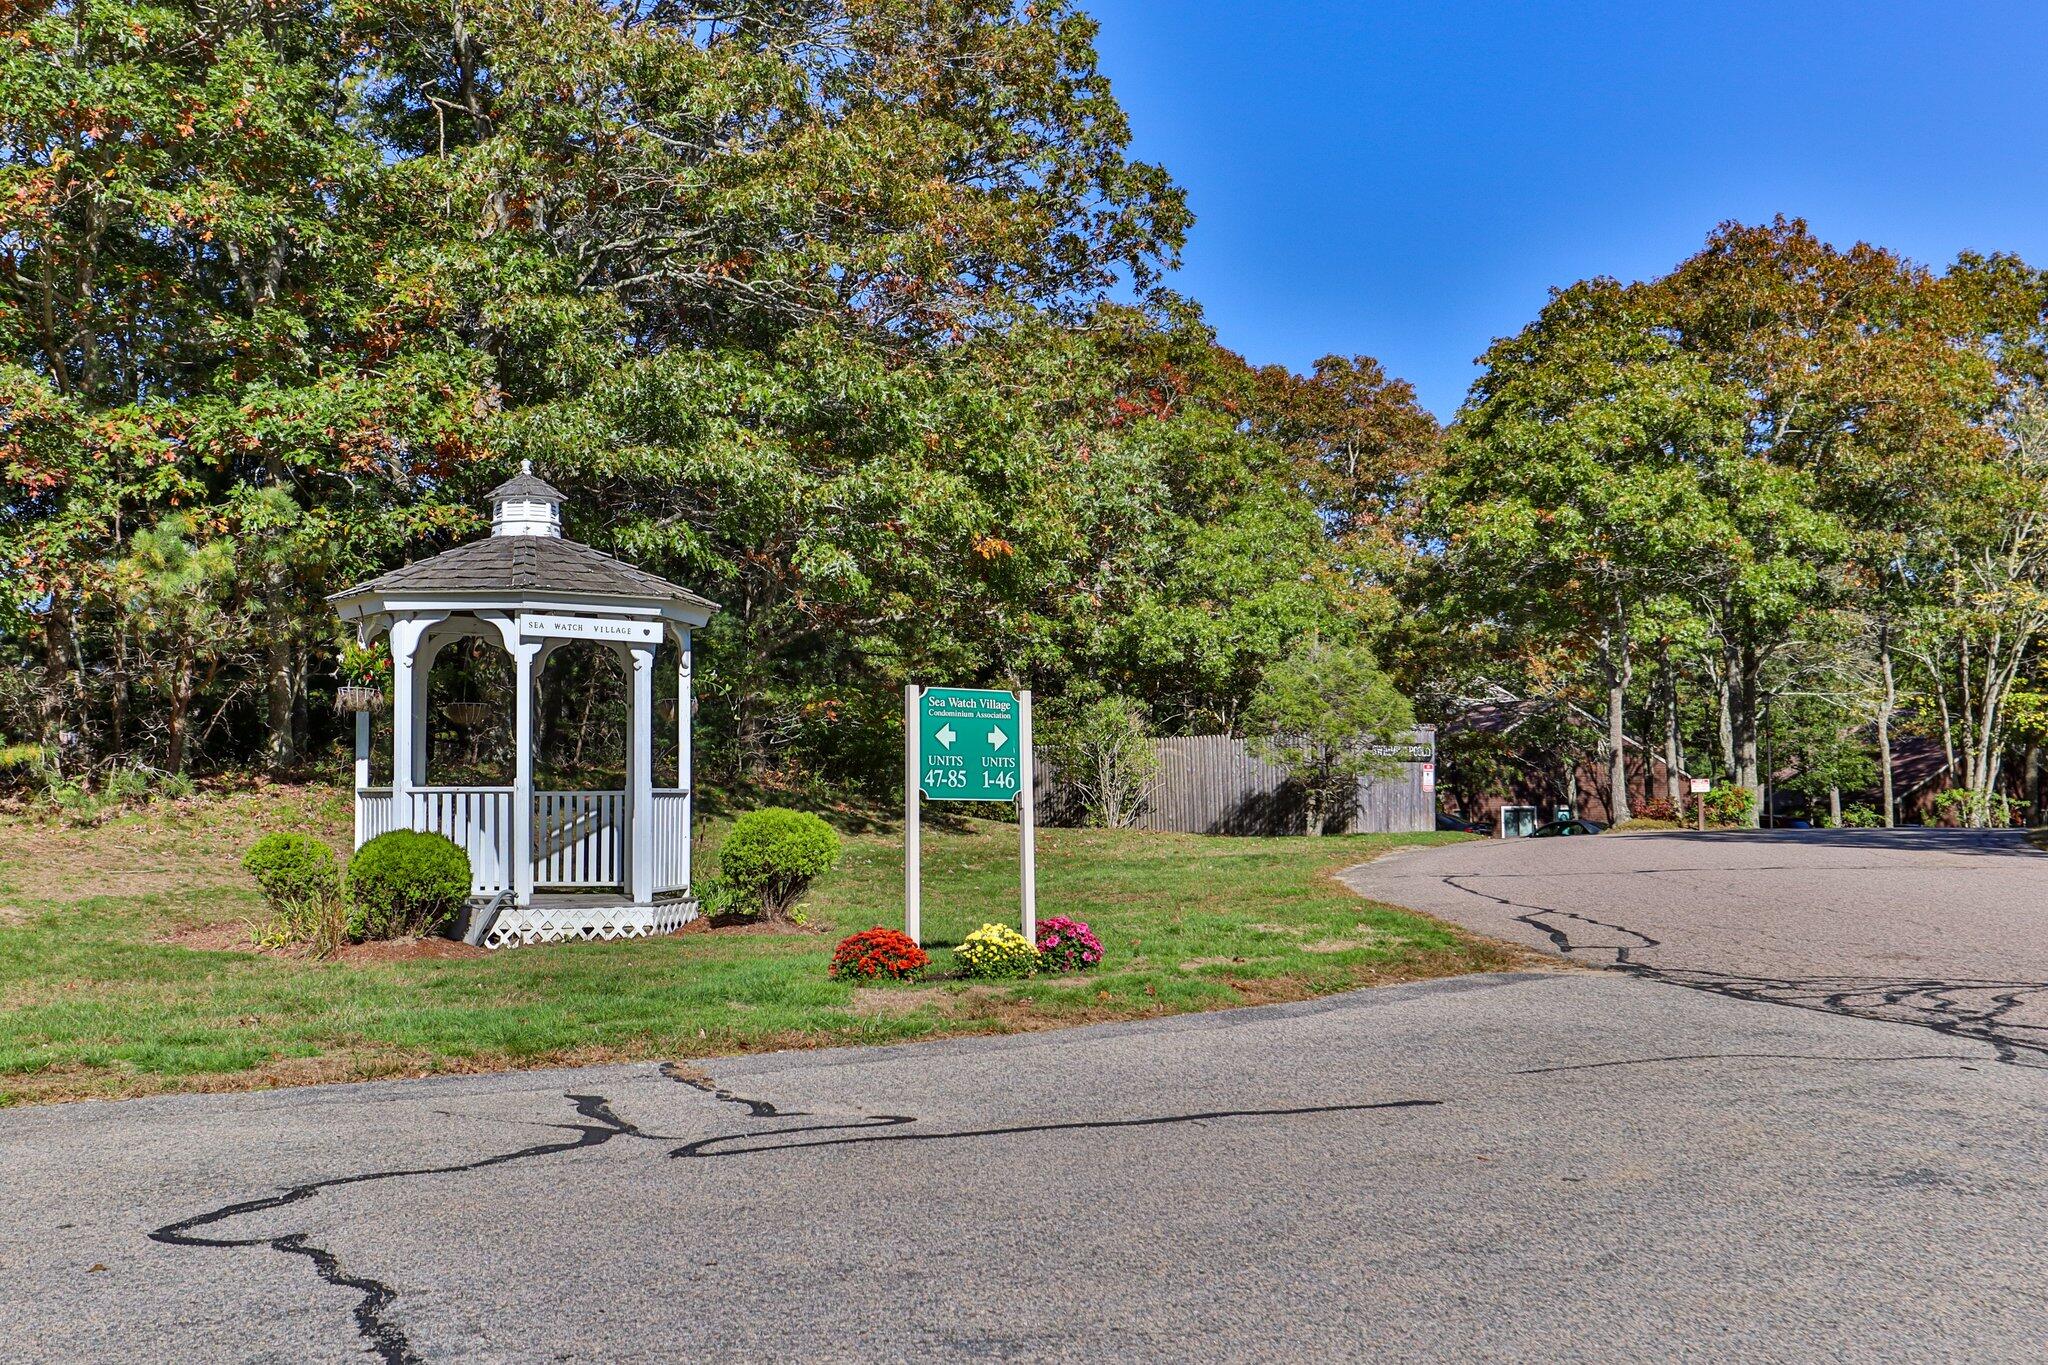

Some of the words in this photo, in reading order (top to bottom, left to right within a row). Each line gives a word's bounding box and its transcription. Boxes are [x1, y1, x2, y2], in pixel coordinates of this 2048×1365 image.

[528, 621, 545, 629] SEA
[554, 623, 583, 632] WATCH
[594, 625, 632, 635] VILLAGE
[928, 696, 946, 707] Sea
[948, 697, 977, 709] Watch
[979, 699, 1011, 712] Village
[928, 708, 974, 718] Condominium
[975, 711, 1011, 720] Association
[928, 755, 964, 766] UNITS
[981, 756, 1016, 768] UNITS
[924, 769, 967, 788] 47-85
[982, 770, 1015, 789] 1-46
